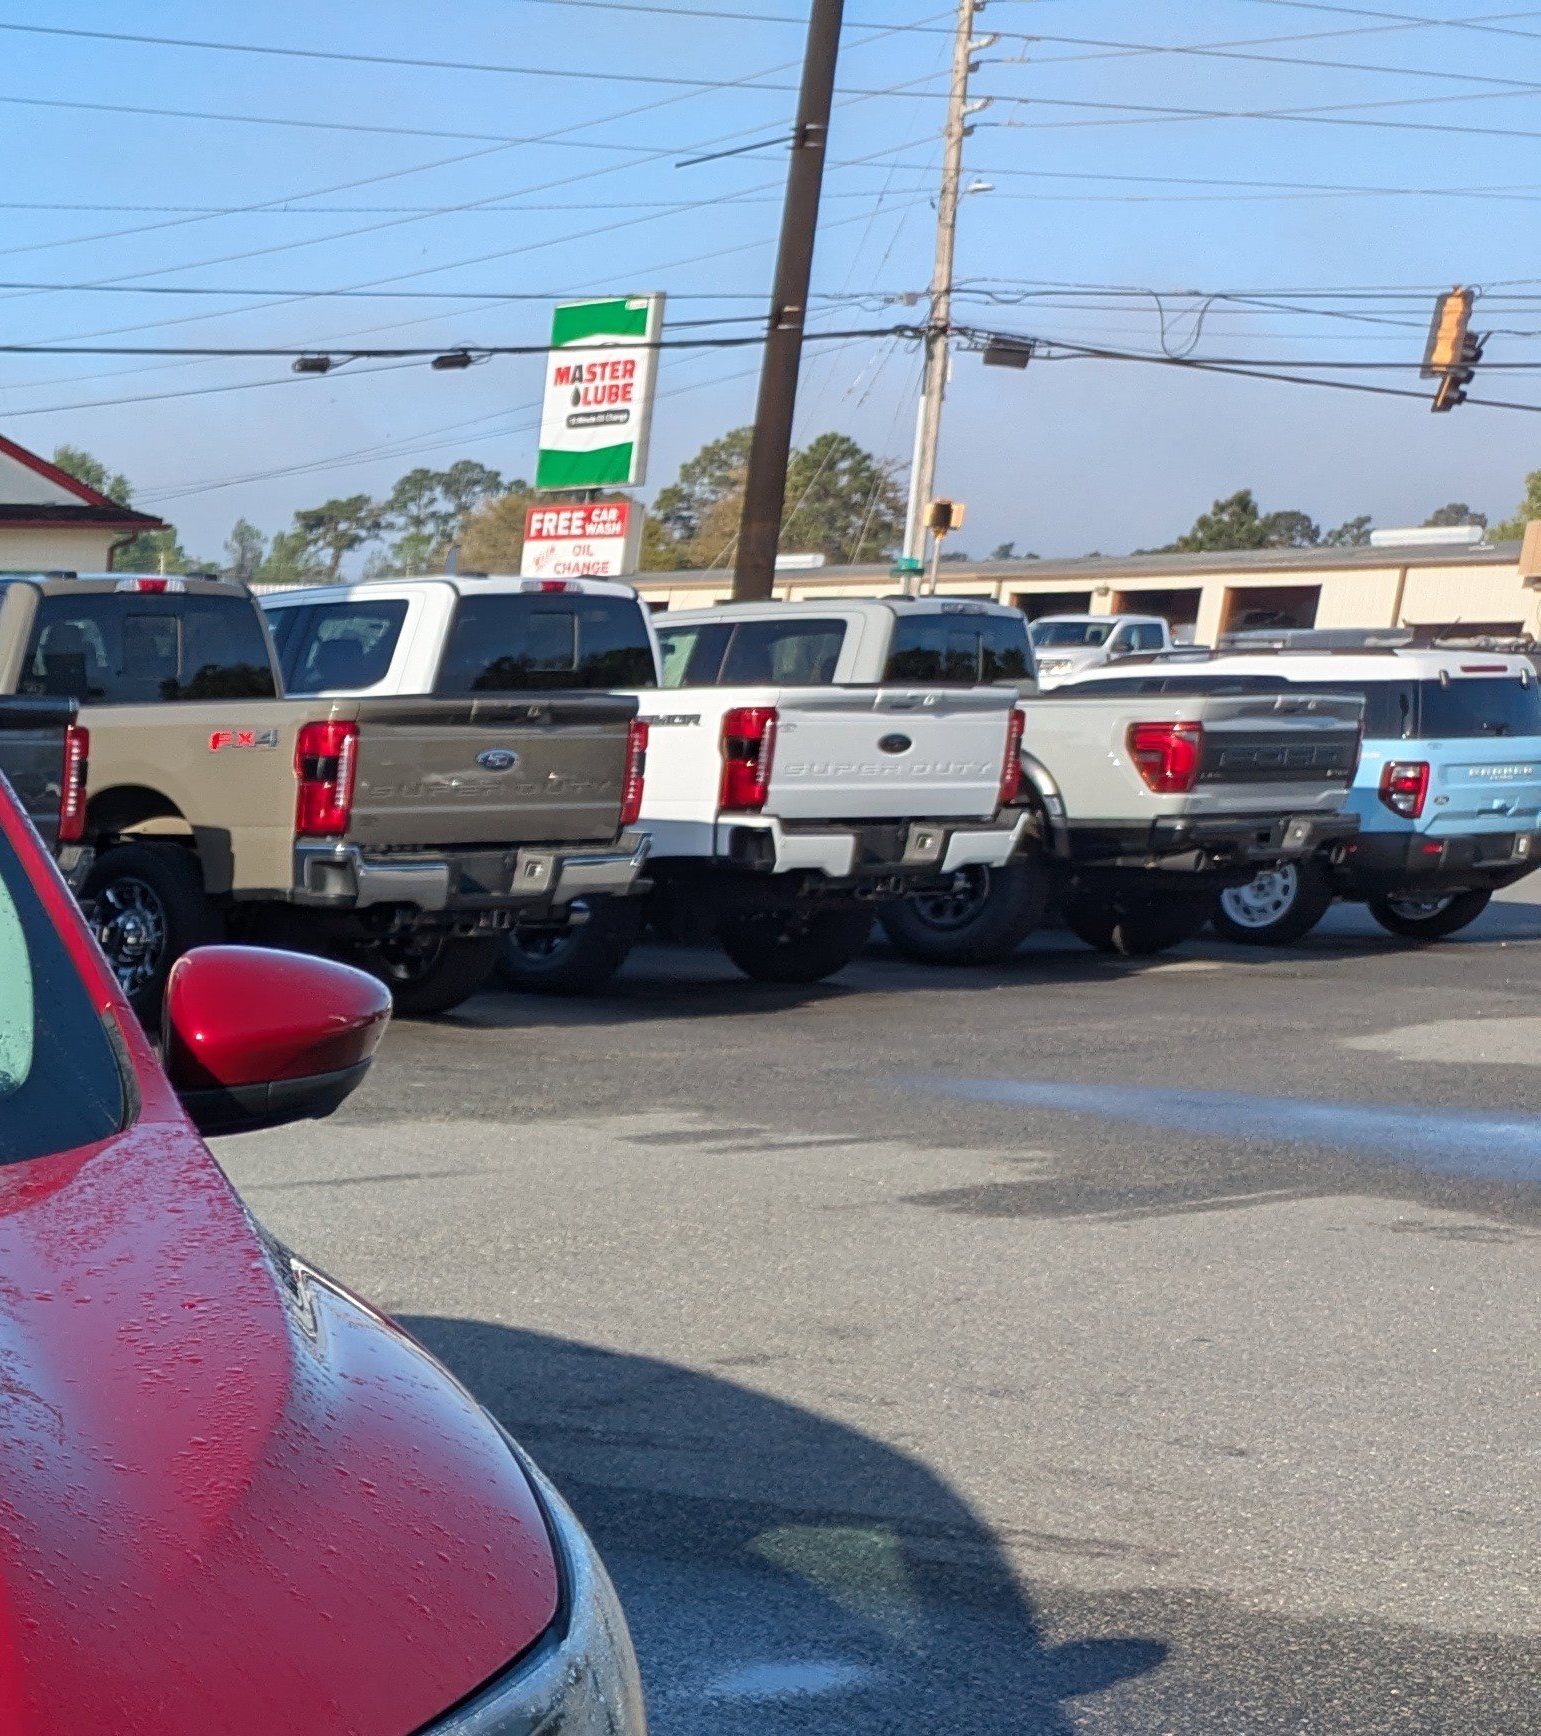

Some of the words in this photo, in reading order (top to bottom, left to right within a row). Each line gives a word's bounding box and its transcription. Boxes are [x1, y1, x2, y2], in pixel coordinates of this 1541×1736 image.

[554, 359, 636, 386] MASTER
[581, 382, 634, 406] LUBE
[591, 507, 619, 522] CAR
[529, 510, 586, 537] FREE
[584, 521, 622, 536] WASH
[572, 543, 594, 557] OIL
[554, 560, 609, 576] CHANGE
[208, 728, 279, 751] FX4
[783, 761, 902, 777] SUPER
[909, 761, 992, 776] DUTY
